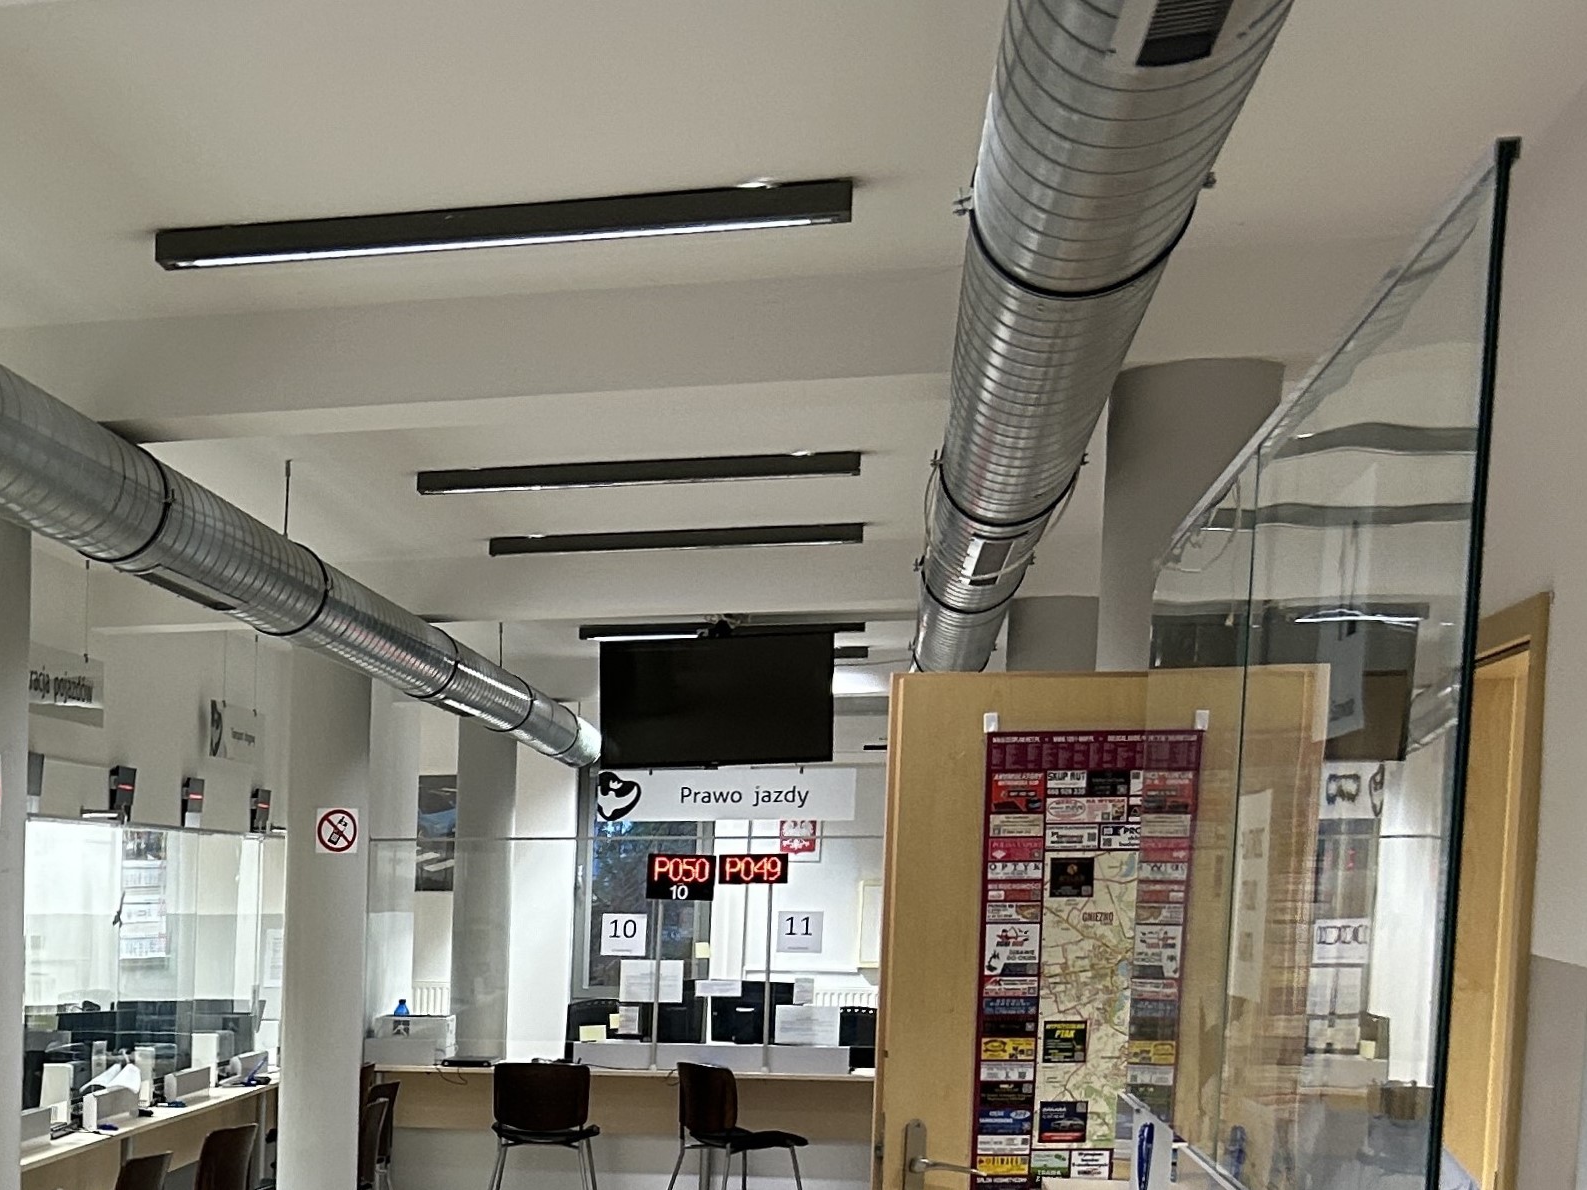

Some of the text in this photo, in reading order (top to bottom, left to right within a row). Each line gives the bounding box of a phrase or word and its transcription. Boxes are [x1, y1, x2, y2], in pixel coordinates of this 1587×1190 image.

[680, 785, 810, 807] Prawo jazdy
[653, 856, 783, 882] P050 P049
[669, 885, 689, 900] 10
[608, 919, 638, 939] 10
[784, 916, 813, 936] 11
